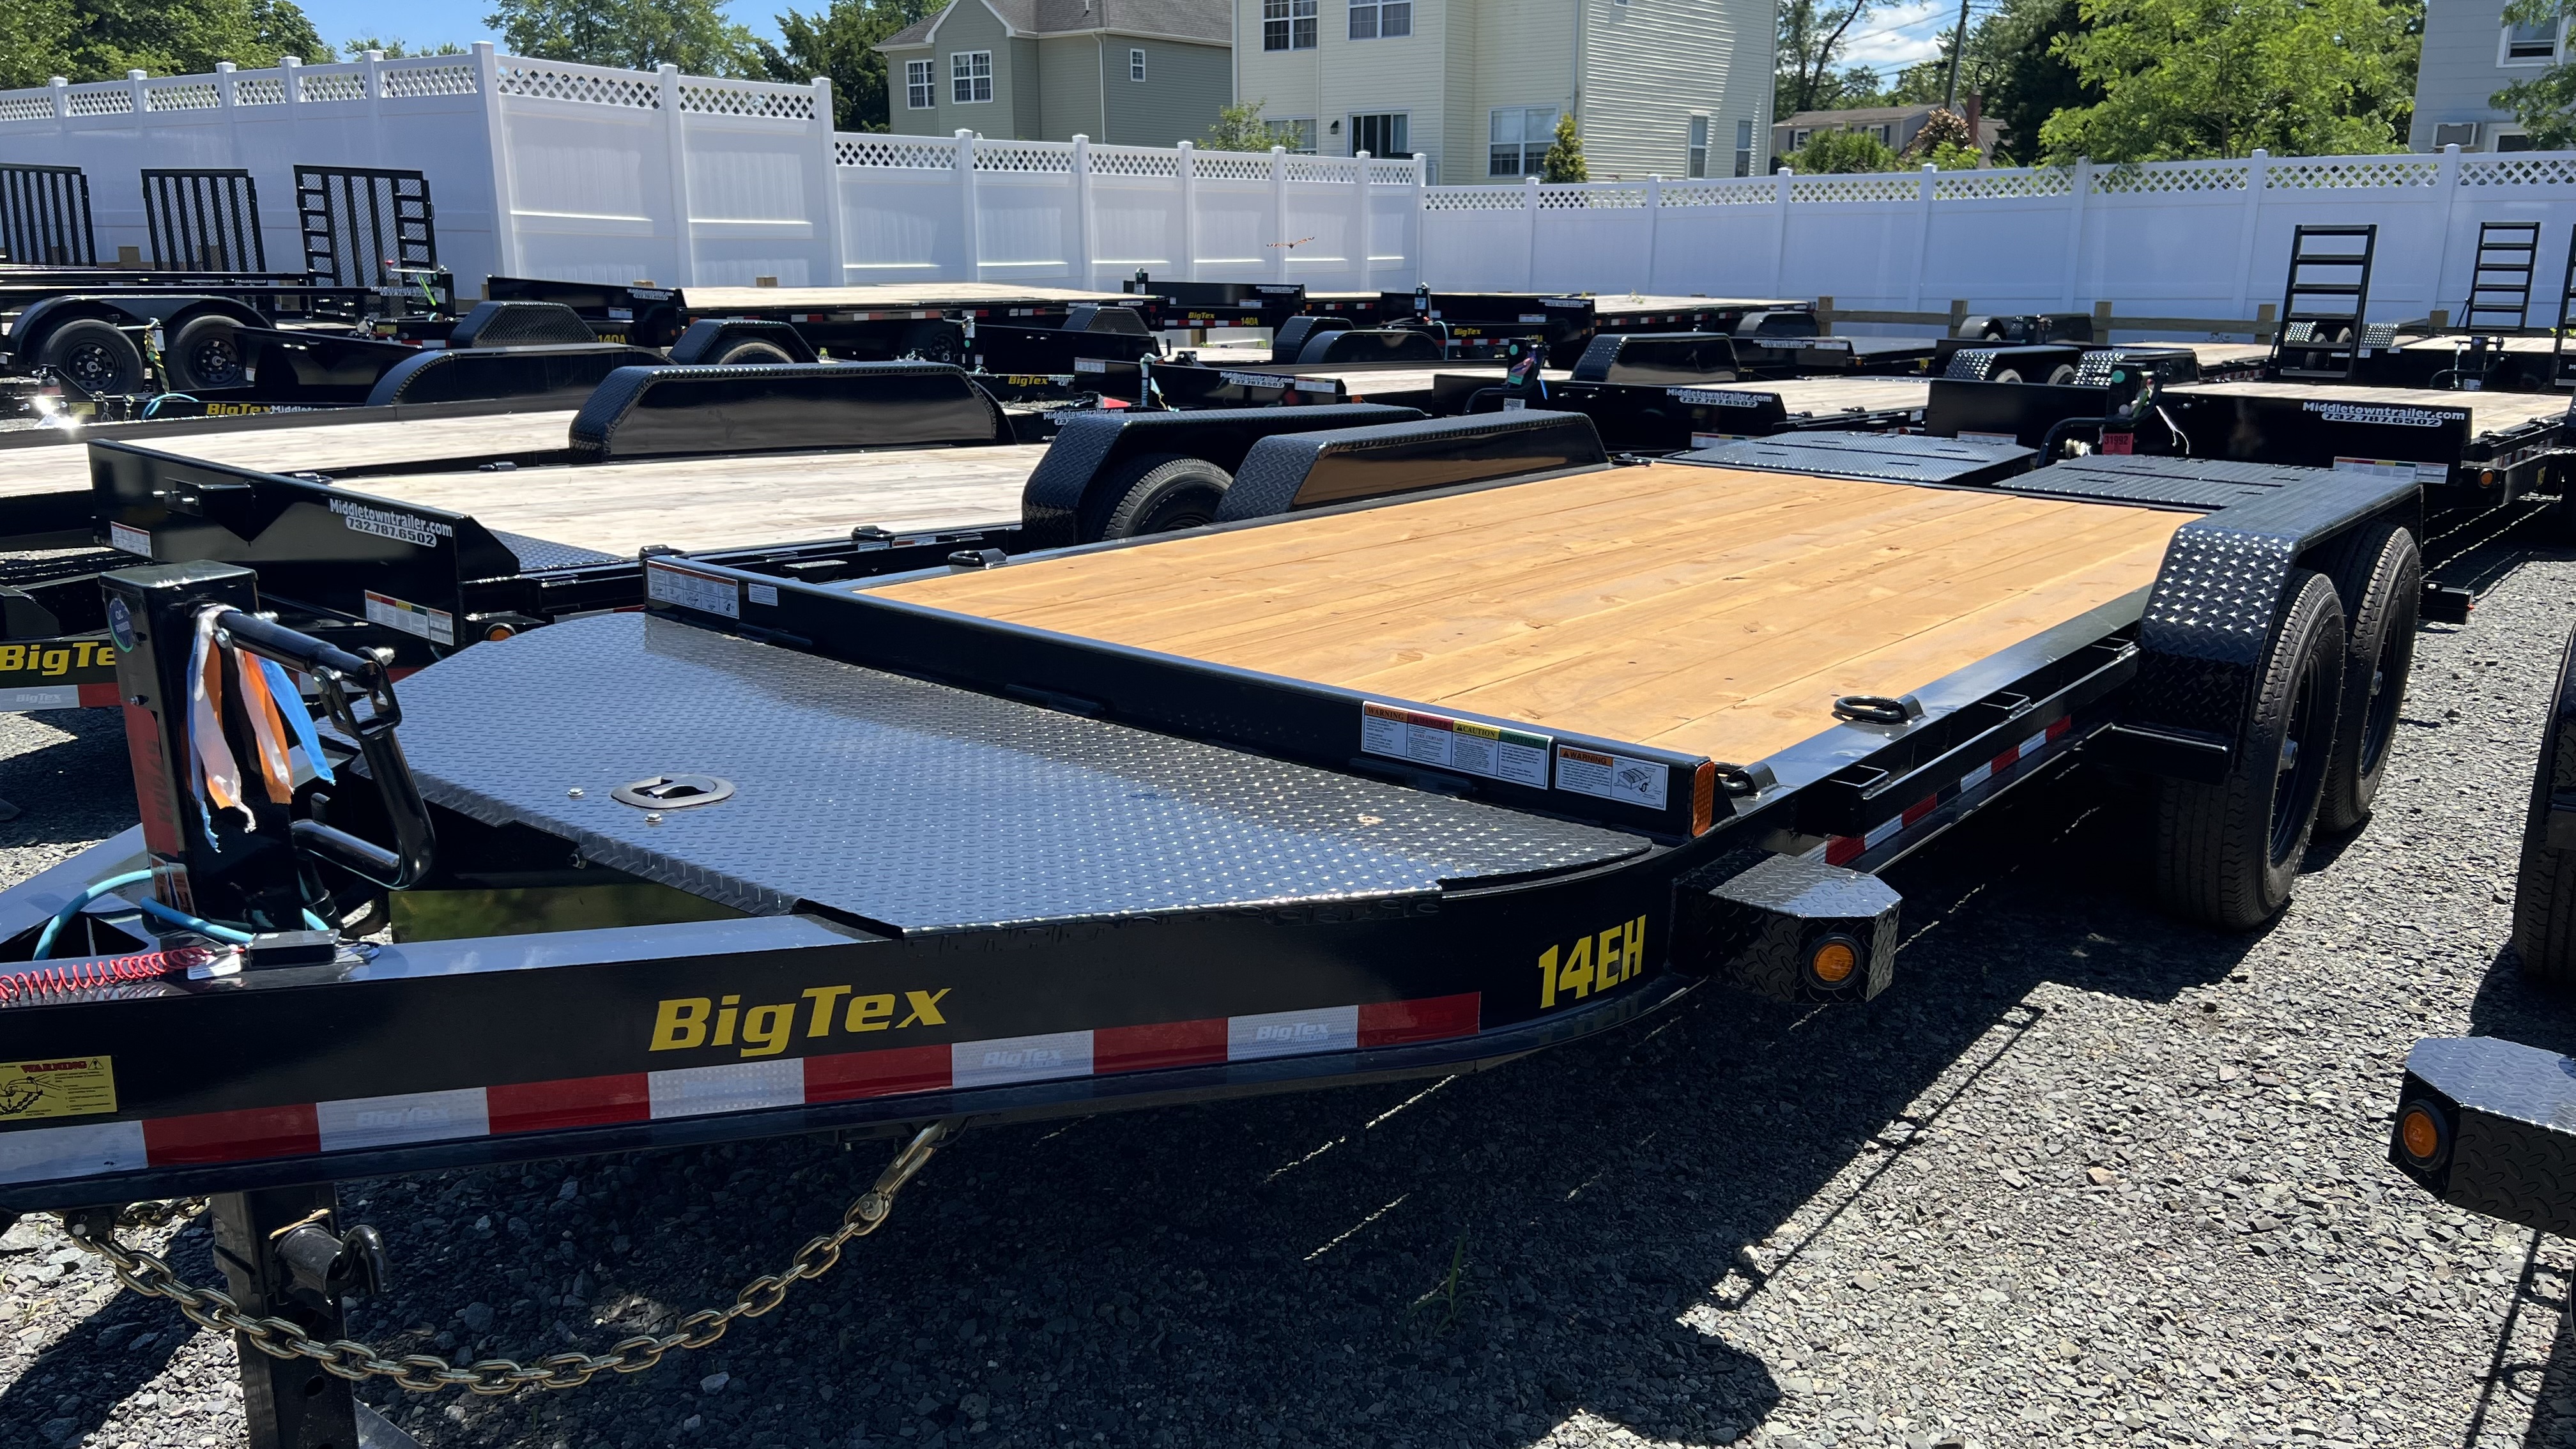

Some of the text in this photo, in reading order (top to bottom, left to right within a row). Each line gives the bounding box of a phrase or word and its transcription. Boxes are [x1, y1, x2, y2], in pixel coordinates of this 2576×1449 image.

[1008, 376, 1048, 387] BigTex
[1666, 388, 1772, 402] Middletowntrailer.com
[1682, 397, 1756, 406] 732.787.6502
[2303, 402, 2465, 420] Middletowntrailer.com
[2326, 413, 2439, 426] 732.787.6502
[330, 498, 453, 538] Middletowntrailer.com
[348, 518, 435, 546] 732.787.6502
[0, 641, 116, 676] BigTe
[16, 693, 62, 703] BigTex
[1367, 707, 1404, 721] WARNING
[1418, 716, 1448, 728] DANGER
[1462, 726, 1496, 737] CAUTION
[1507, 733, 1539, 746] NOTICE
[1569, 751, 1607, 764] WARNING
[1538, 914, 1646, 1009] 14EH
[648, 985, 953, 1058] BigTex
[1256, 1022, 1331, 1041] BigTex
[981, 1048, 1063, 1068] BigTex
[20, 1061, 88, 1073] WARNING
